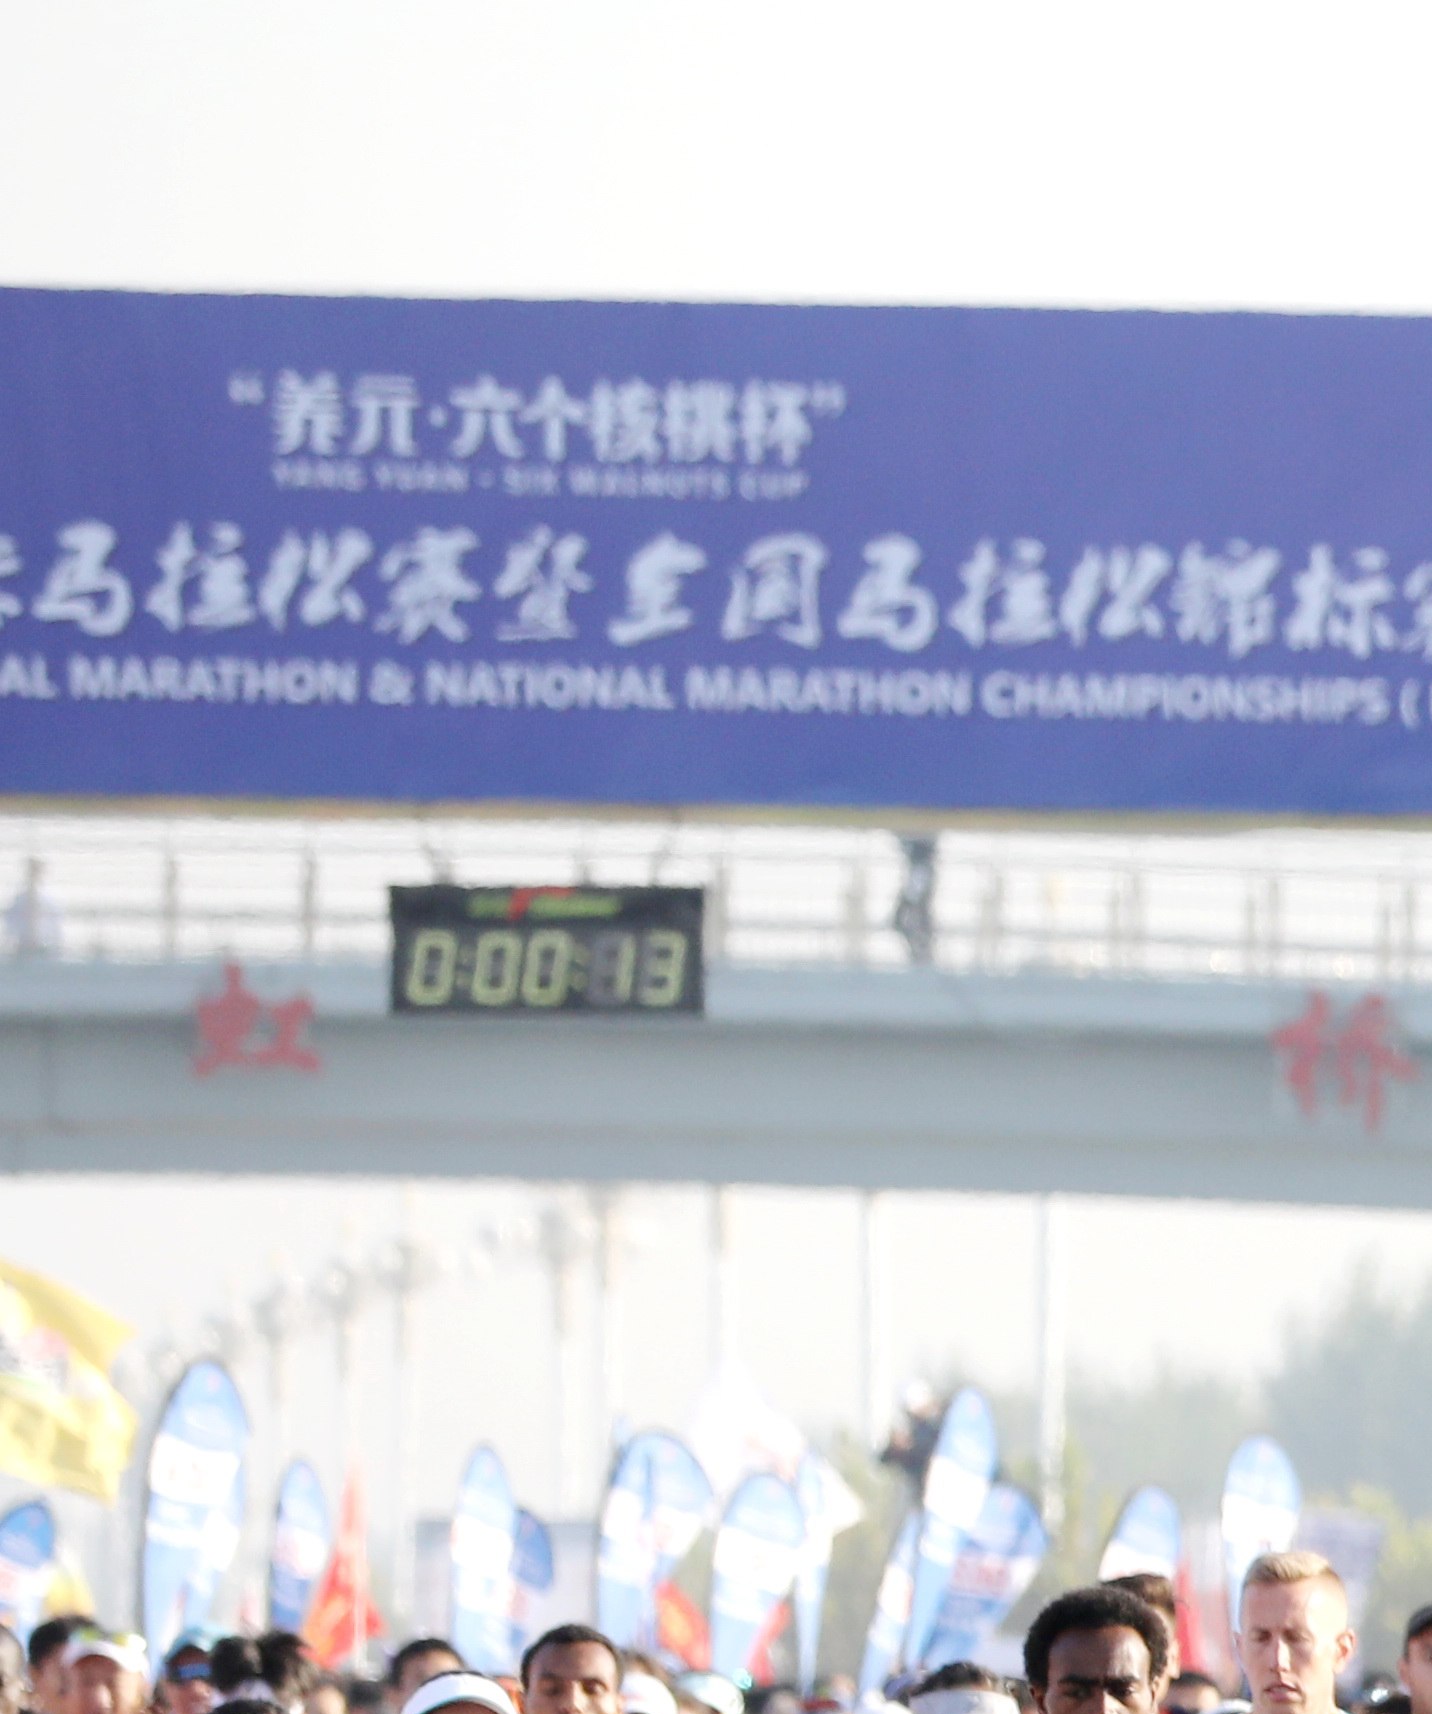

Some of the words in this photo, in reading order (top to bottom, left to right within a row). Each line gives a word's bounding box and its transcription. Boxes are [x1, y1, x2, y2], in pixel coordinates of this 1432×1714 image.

[68, 654, 358, 704] MARATHON
[370, 659, 413, 706] &
[424, 660, 674, 711] NATIONAL
[685, 663, 973, 718] MARATHON
[981, 670, 1391, 729] CHAMPIONSHIPS
[404, 926, 690, 1008] 0:00:13
